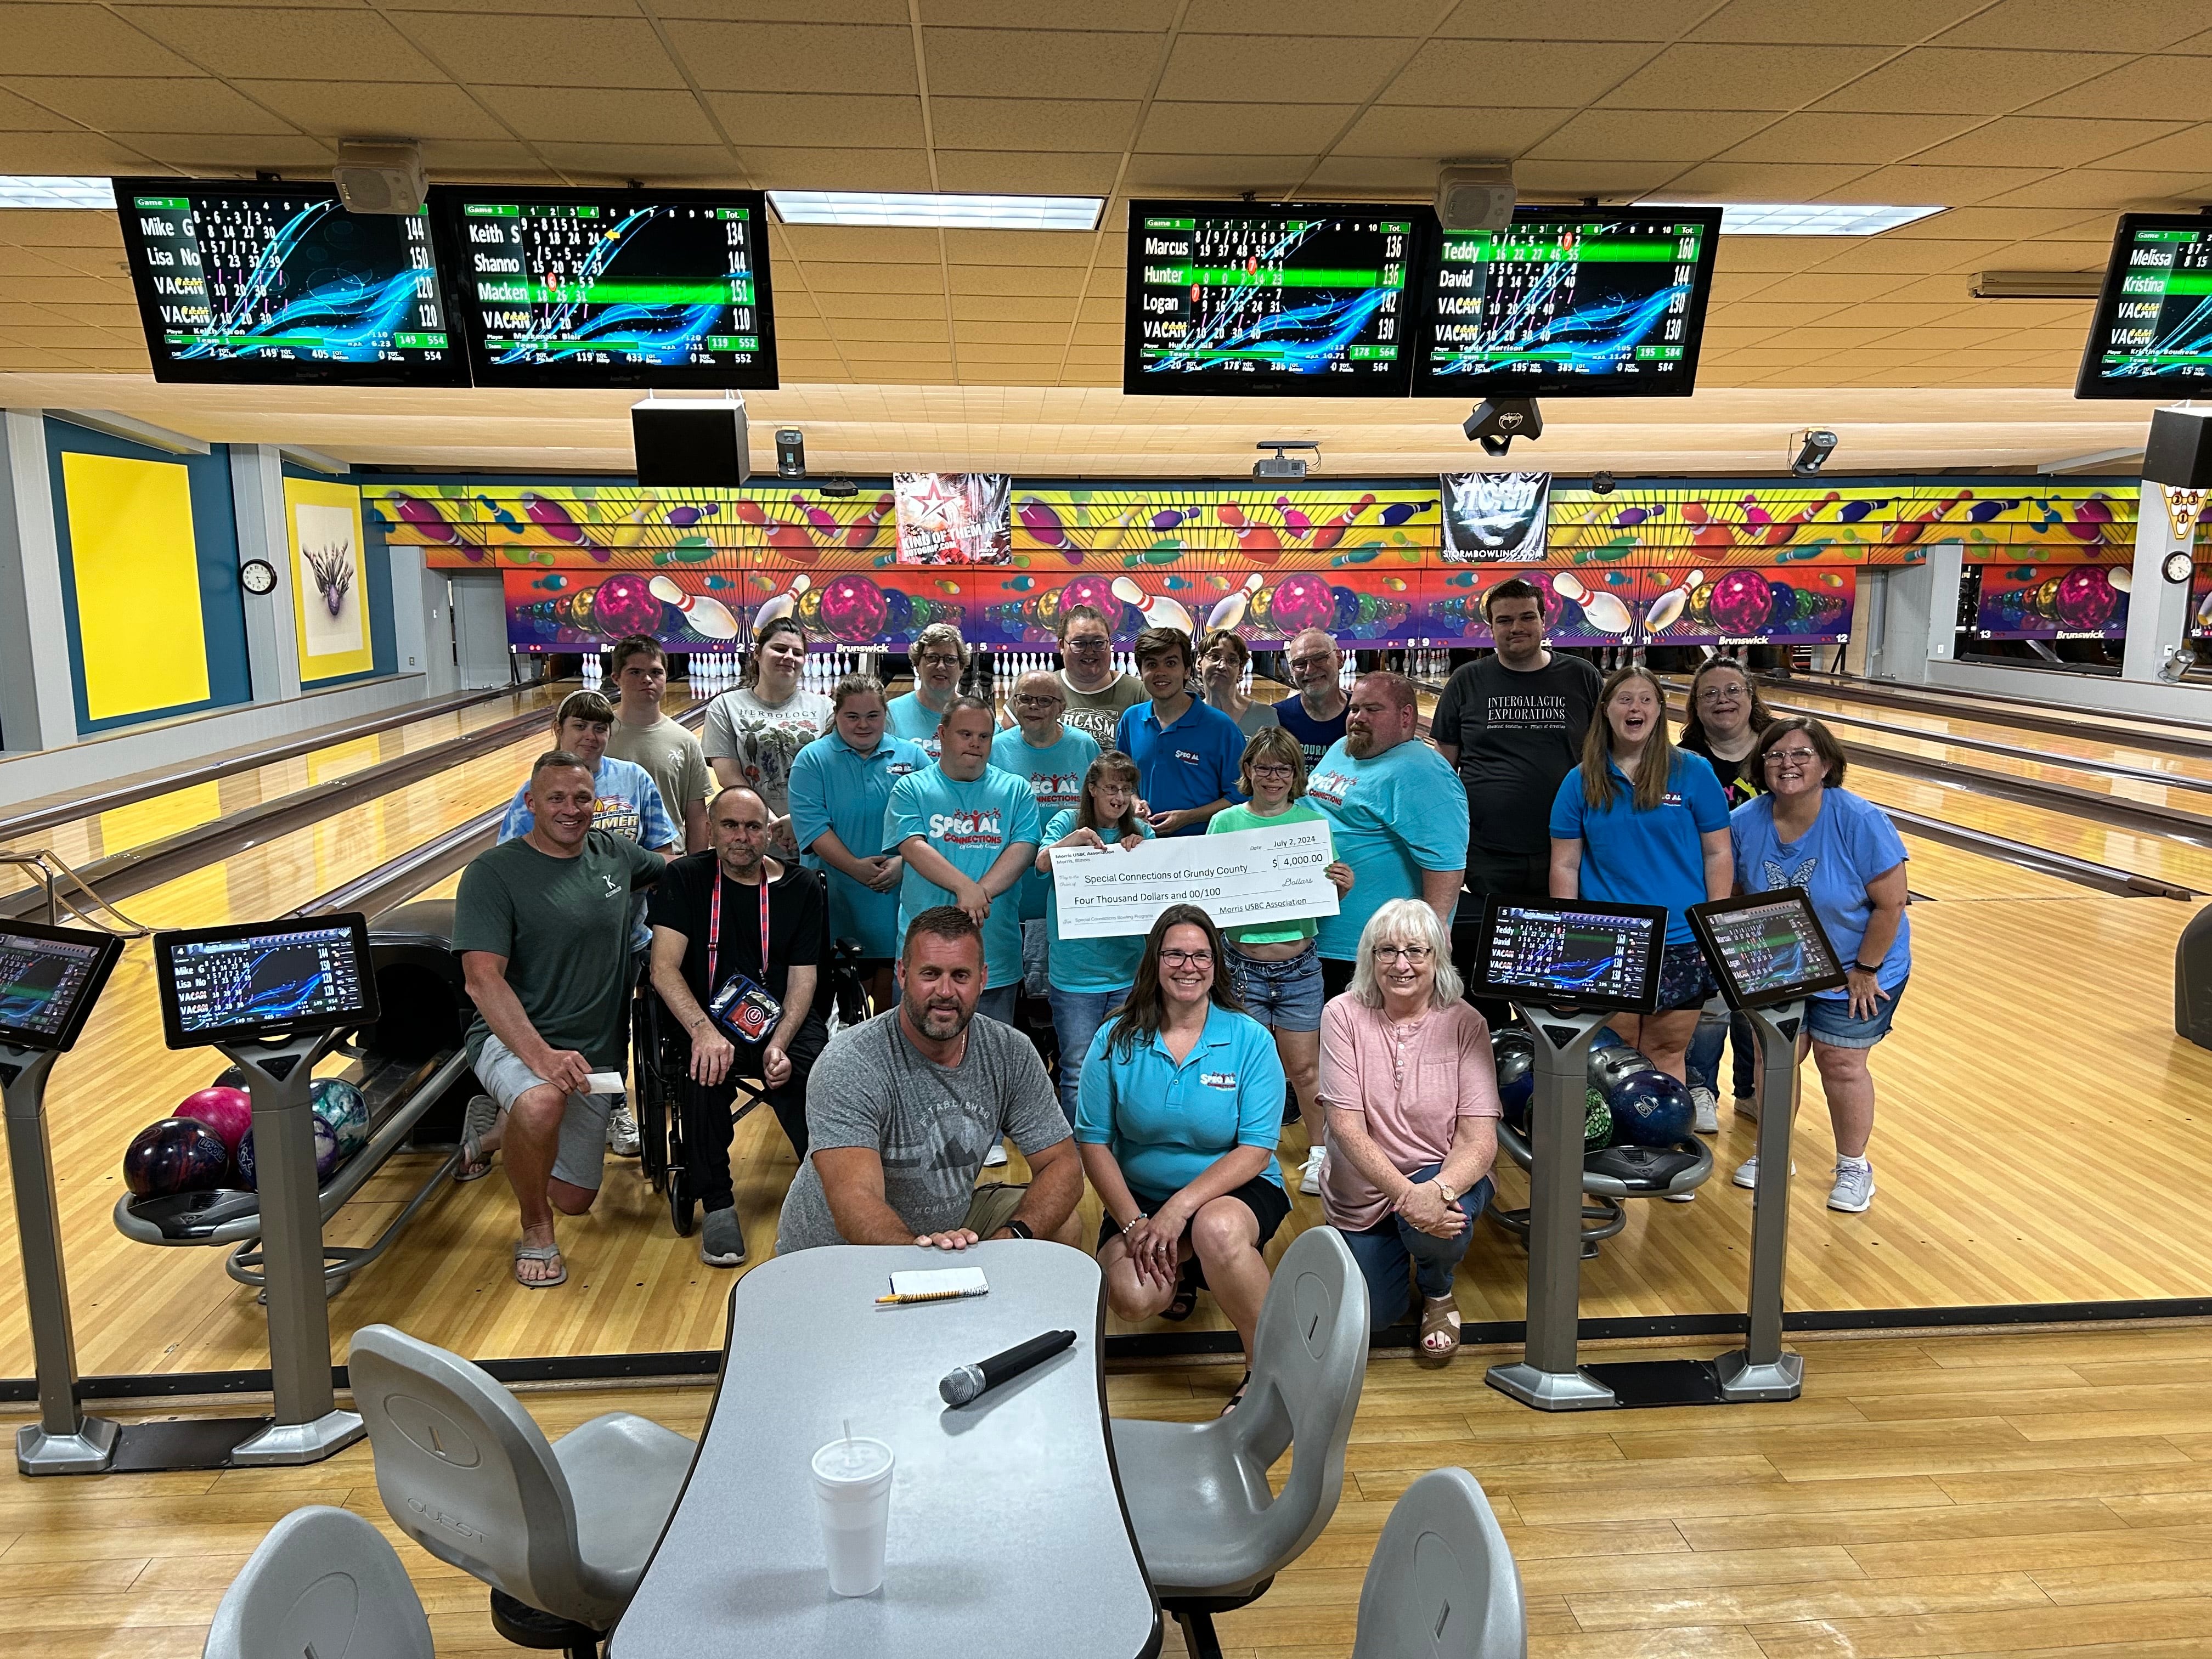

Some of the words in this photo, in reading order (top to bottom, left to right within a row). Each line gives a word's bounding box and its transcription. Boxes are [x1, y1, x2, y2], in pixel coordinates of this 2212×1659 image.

[140, 217, 174, 236] Mike
[183, 218, 194, 236] G
[405, 217, 425, 240] 144
[469, 223, 504, 243] Keith
[511, 225, 520, 244] S
[726, 222, 743, 245] 134
[1389, 224, 1402, 232] Tot.
[1145, 237, 1189, 256] Marcus
[1385, 235, 1402, 258] 136
[1443, 241, 1480, 263] Teddy
[1677, 237, 1695, 259] 160
[147, 247, 174, 266] Lisa
[180, 248, 200, 266] No
[410, 247, 428, 269] 150
[474, 252, 520, 272] Shanno
[729, 251, 746, 273] 144
[2130, 249, 2172, 267] Melissa
[1144, 266, 1183, 284] Hunter
[1383, 263, 1400, 285] 136
[1440, 269, 1473, 287] David
[1673, 265, 1690, 286] 144
[415, 276, 433, 298] 120
[477, 281, 528, 301] Macken
[730, 279, 748, 302] 151
[2123, 276, 2165, 293] Kristina
[1143, 293, 1178, 314] Logan
[1380, 291, 1397, 313] 142
[1668, 292, 1685, 313] 130
[419, 304, 437, 327] 120
[733, 307, 751, 331] 110
[1378, 318, 1394, 340] 130
[1664, 319, 1681, 340] 130
[399, 335, 416, 345] 149
[428, 335, 444, 345] 554
[712, 338, 728, 347] 119
[740, 338, 756, 347] 552
[1354, 347, 1369, 356] 178
[1379, 347, 1395, 357] 564
[1639, 347, 1656, 357] 195
[1664, 347, 1680, 357] 584
[2175, 495, 2180, 504] 2
[949, 522, 983, 540] THEM
[985, 520, 1006, 534] ALL
[1442, 549, 1544, 558] STORMBOWLING.COM
[1836, 634, 1848, 643] 12
[1979, 630, 1991, 639] 13
[2056, 630, 2106, 640] Brunswick
[2191, 629, 2202, 637] 15
[736, 643, 745, 652] 2
[979, 642, 987, 651] 5
[1407, 638, 1415, 647] 8
[1421, 638, 1430, 647] 9
[1621, 636, 1633, 645] 10
[1642, 636, 1651, 645] 11
[1718, 636, 1769, 646] Brunswick
[511, 644, 517, 653] 1
[836, 643, 890, 653] Brunswick
[1488, 696, 1566, 708] INTERGALACTIC
[739, 709, 817, 719] HERBOLOGY
[1488, 708, 1566, 720] EXPLORATIONS
[1063, 714, 1115, 738] RCASM
[1031, 780, 1079, 794] ECIAL
[1036, 794, 1081, 803] NNECTIONS
[944, 833, 1002, 844] CONNECTIONS
[1273, 839, 1287, 848] July
[1298, 836, 1316, 844] 2024
[1272, 859, 1278, 868] $
[1283, 854, 1323, 866] 4,000.00
[1085, 873, 1116, 885] Special
[1119, 871, 1172, 882] Connections
[1173, 870, 1182, 878] of
[1183, 868, 1215, 878] Grundy
[1216, 864, 1248, 875] County
[1074, 896, 1094, 905] Four
[1097, 893, 1138, 904] Thousand
[1141, 893, 1169, 901] Dollars
[1171, 890, 1187, 899] and
[1189, 887, 1221, 899] 00/100
[1220, 906, 1243, 914] Morris
[1245, 902, 1264, 911] USBC
[1266, 898, 1307, 908] Association
[1495, 926, 1515, 936] Teddy
[1493, 937, 1511, 946] David
[174, 966, 194, 976] Mike
[198, 965, 205, 974] G
[176, 980, 191, 989] Lisa
[195, 978, 207, 988] No
[408, 1498, 490, 1543] QUEST
